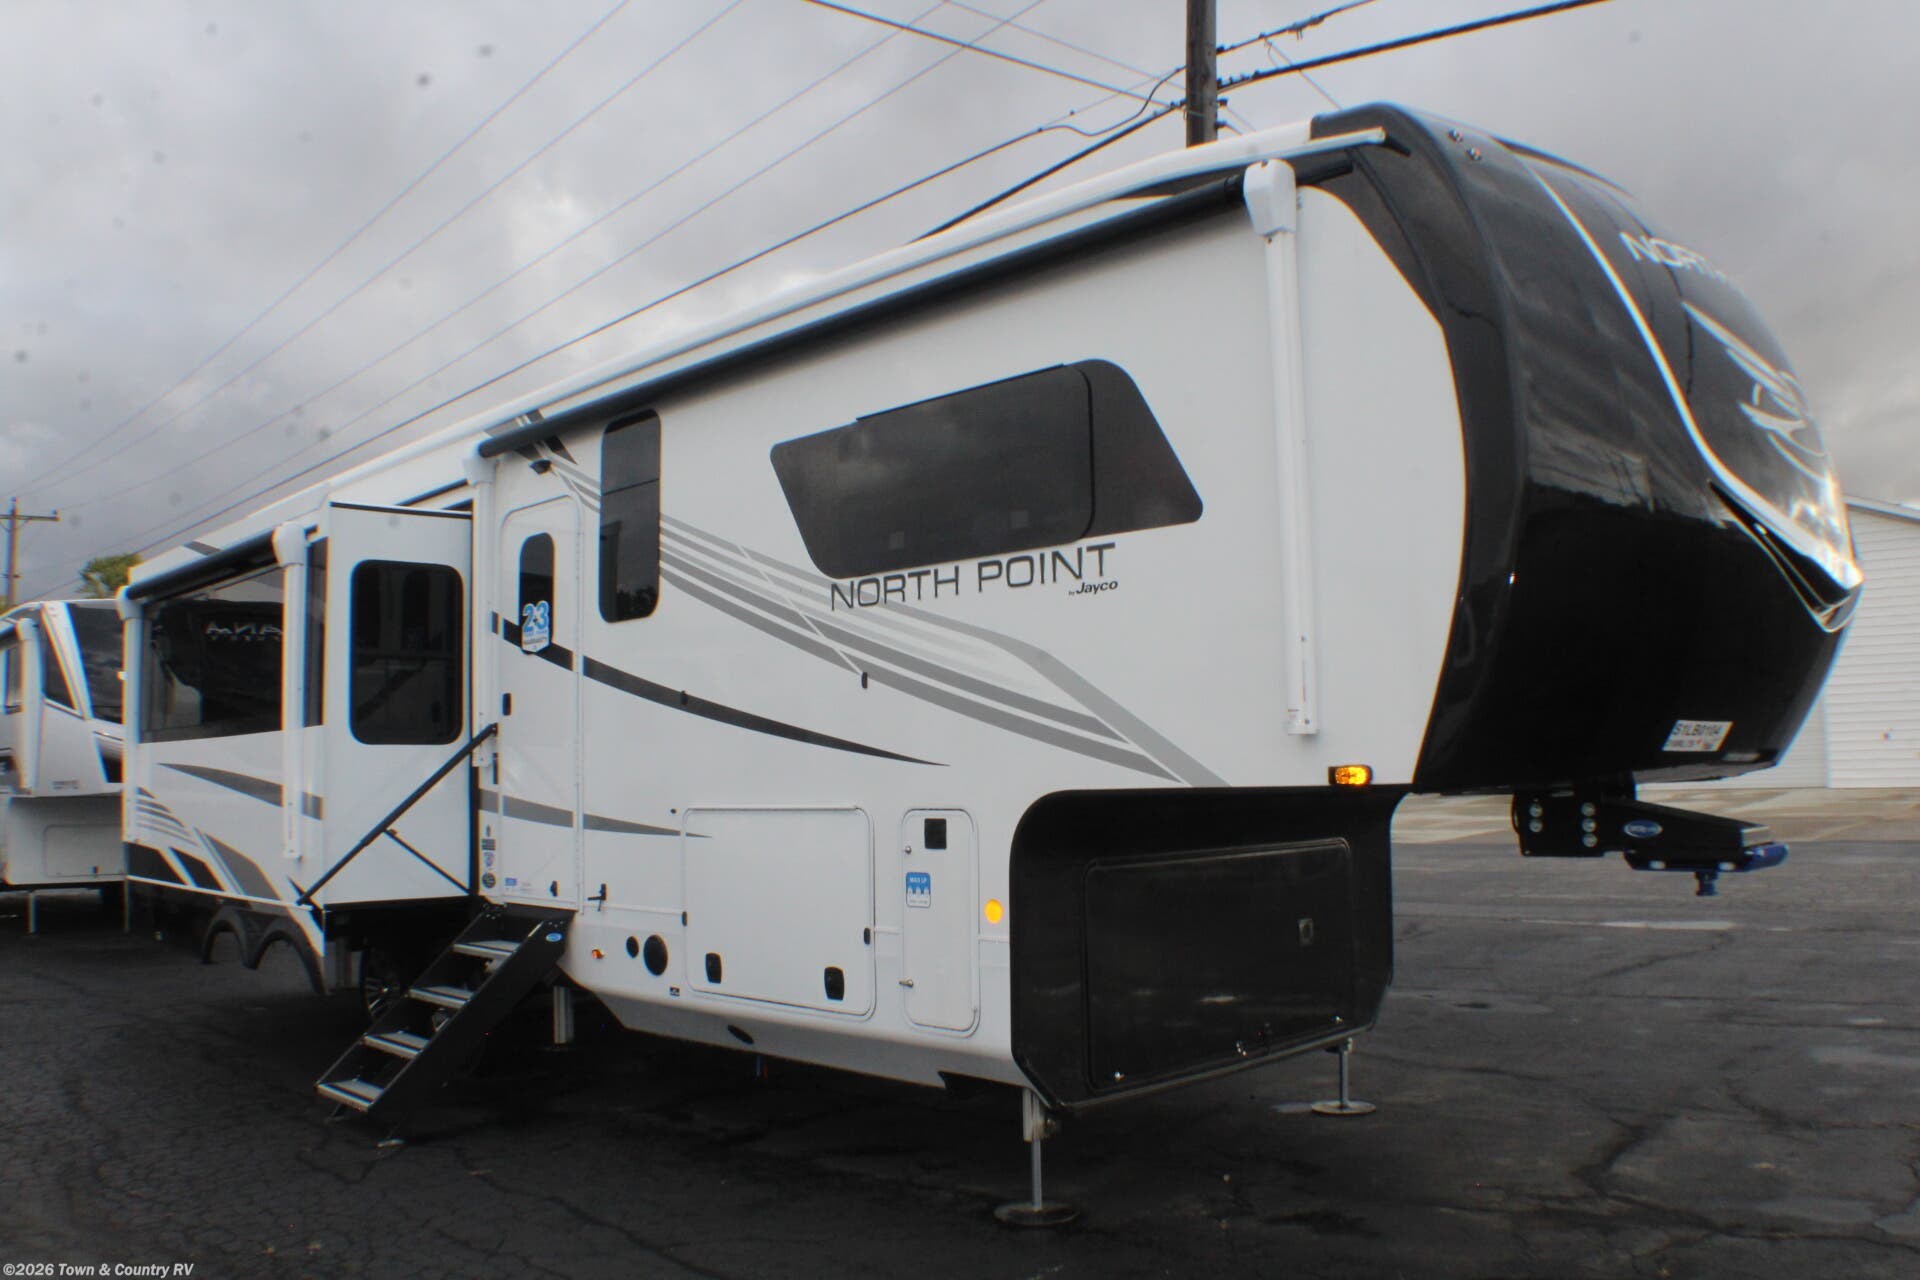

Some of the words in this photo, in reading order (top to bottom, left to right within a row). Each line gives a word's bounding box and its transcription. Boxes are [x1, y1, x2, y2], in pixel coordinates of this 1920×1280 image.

[831, 565, 960, 611] NORTH
[978, 542, 1116, 593] POINT
[1076, 580, 1119, 595] Jayco
